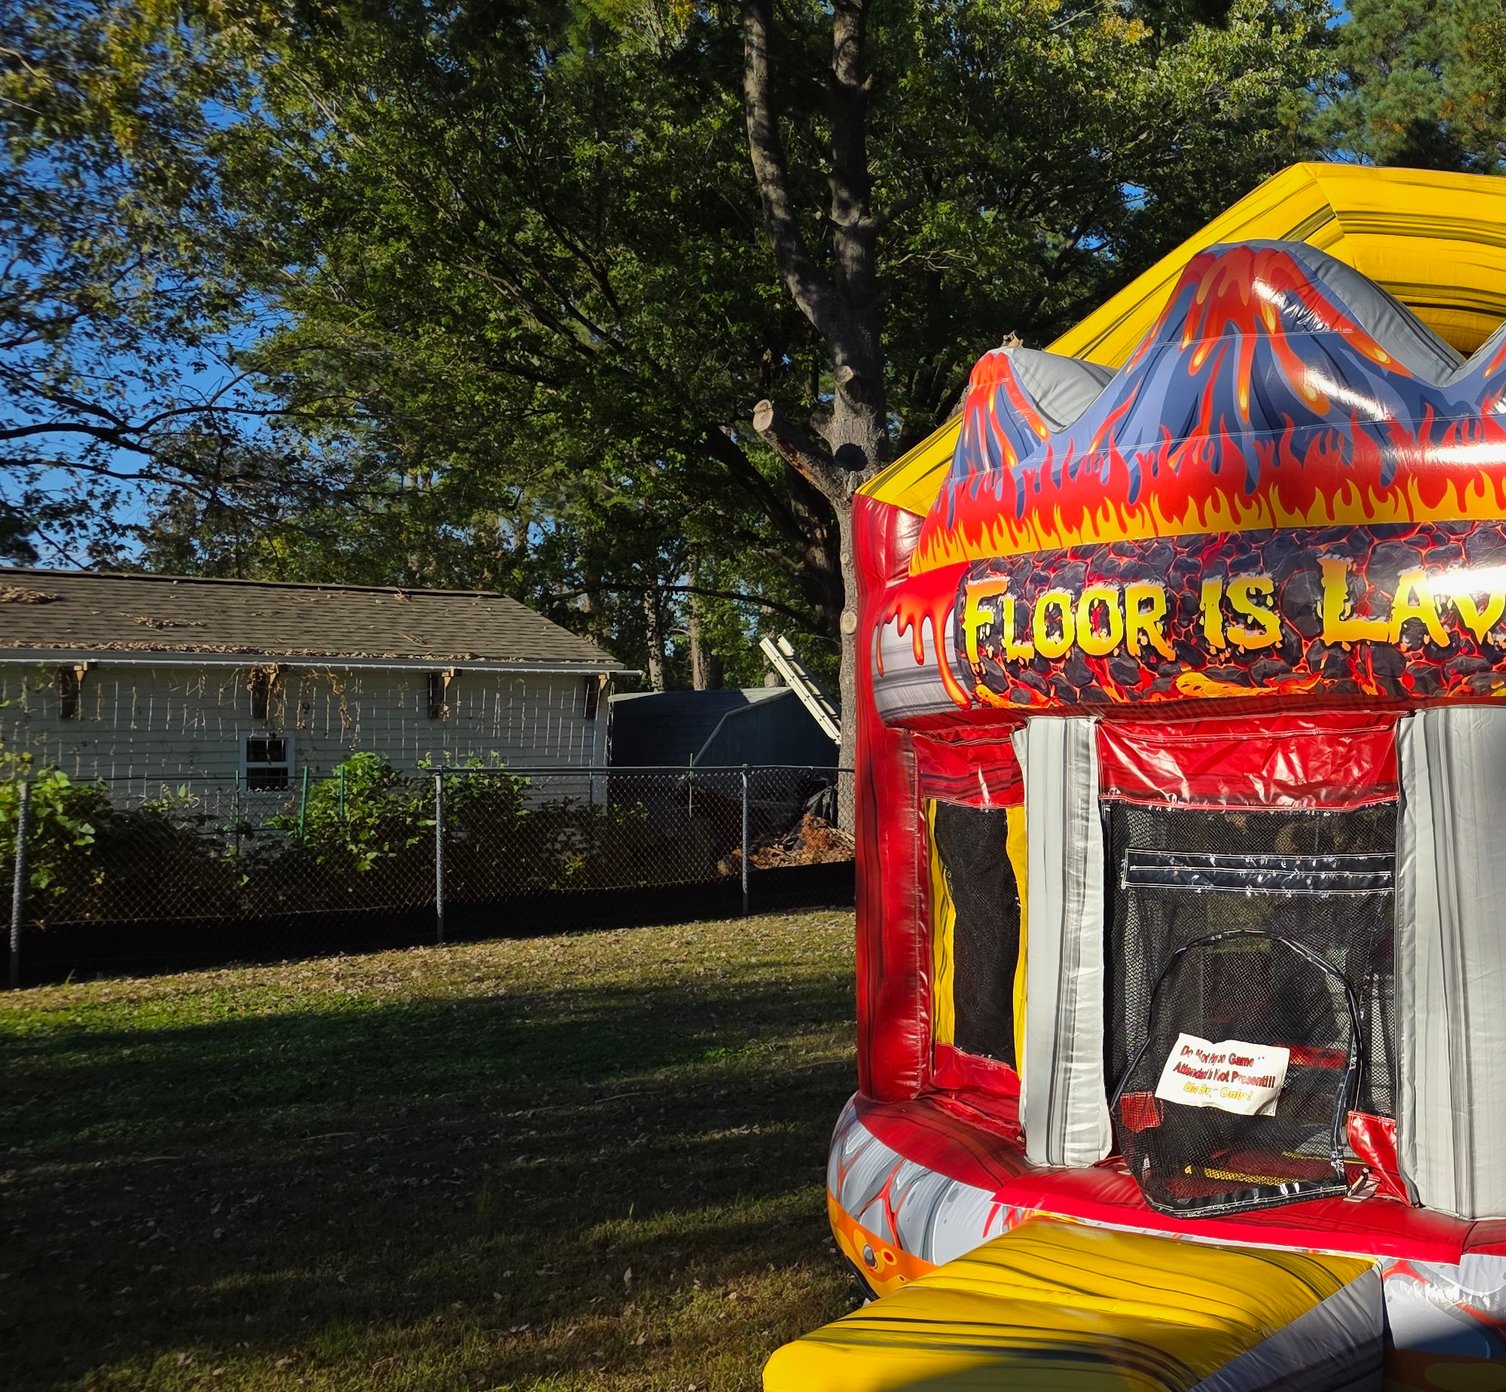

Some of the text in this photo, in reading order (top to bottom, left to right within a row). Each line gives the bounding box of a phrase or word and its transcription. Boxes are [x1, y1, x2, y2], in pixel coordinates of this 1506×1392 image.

[960, 574, 1176, 666] FLOOR
[1200, 572, 1282, 652] IS
[1229, 1053, 1255, 1068] Game
